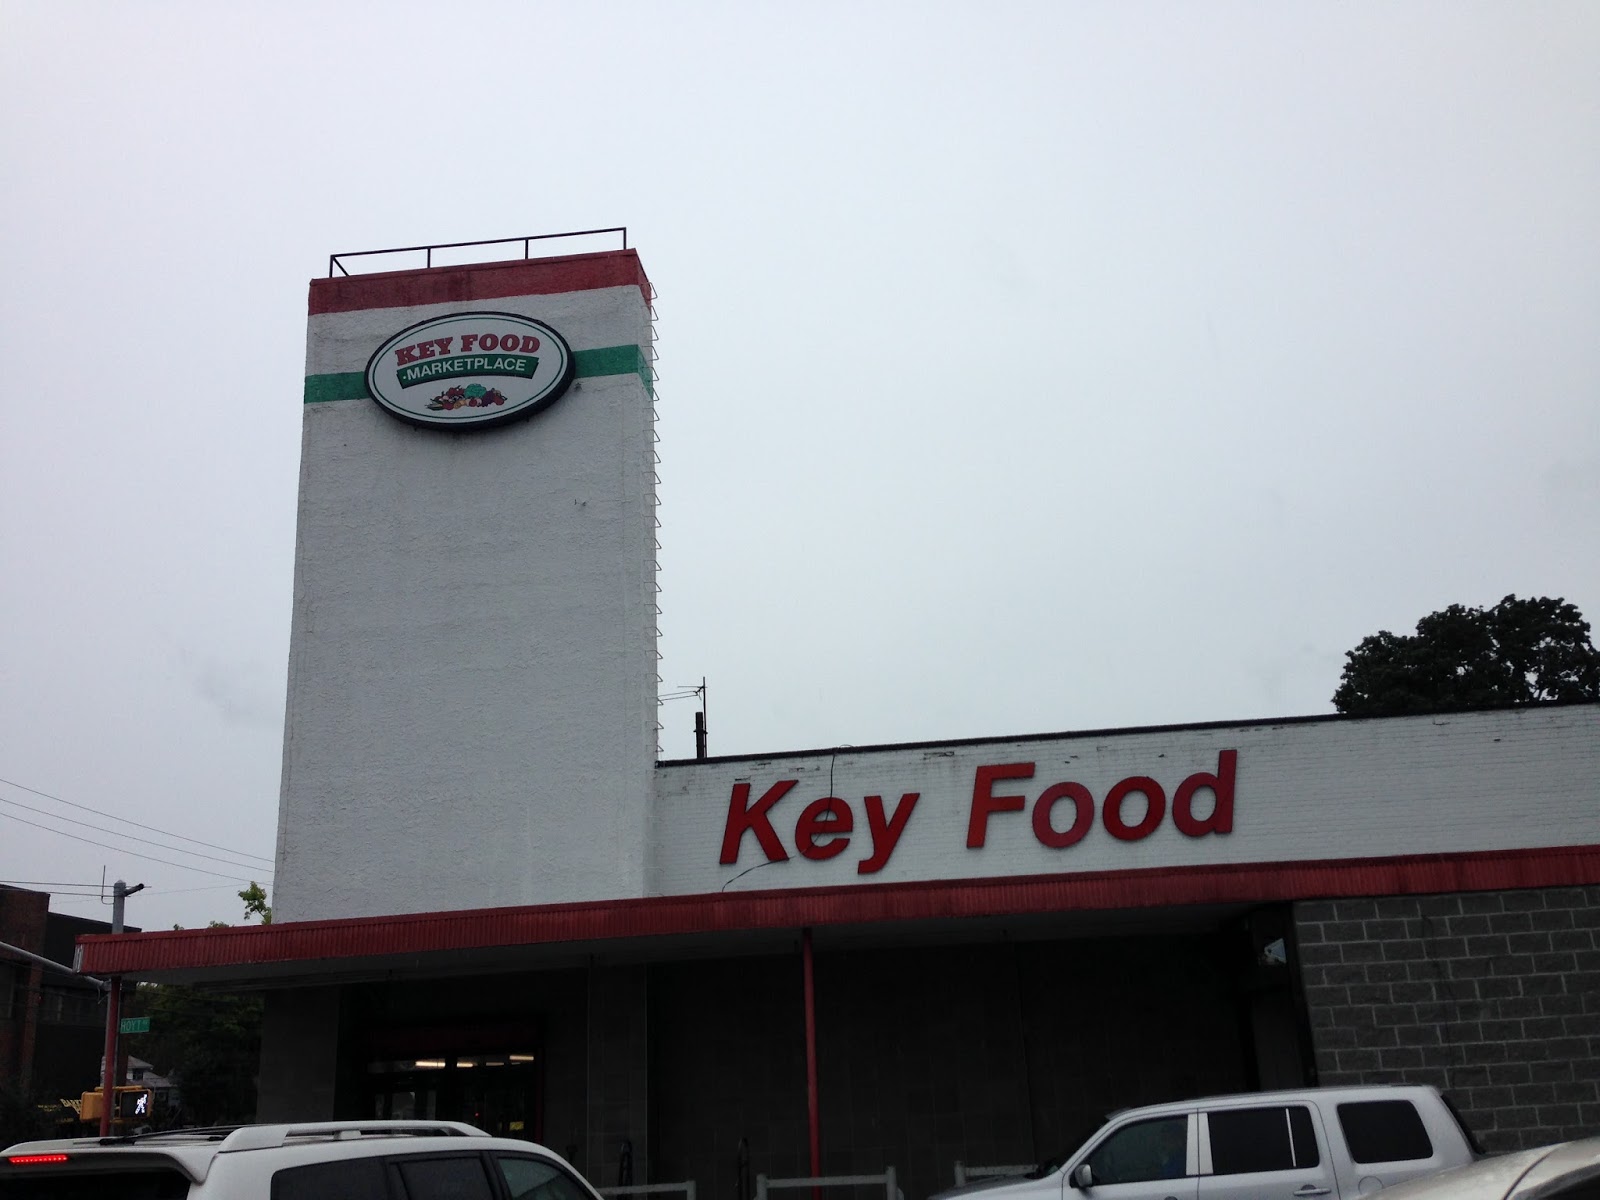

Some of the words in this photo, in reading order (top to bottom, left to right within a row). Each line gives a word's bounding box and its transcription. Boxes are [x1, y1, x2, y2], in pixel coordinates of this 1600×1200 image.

[395, 337, 453, 366] KEY
[460, 333, 541, 354] FOOD
[406, 358, 525, 380] MARKETPLACE
[719, 779, 920, 875] Key
[966, 749, 1237, 849] Food
[120, 1019, 141, 1032] HOYT
